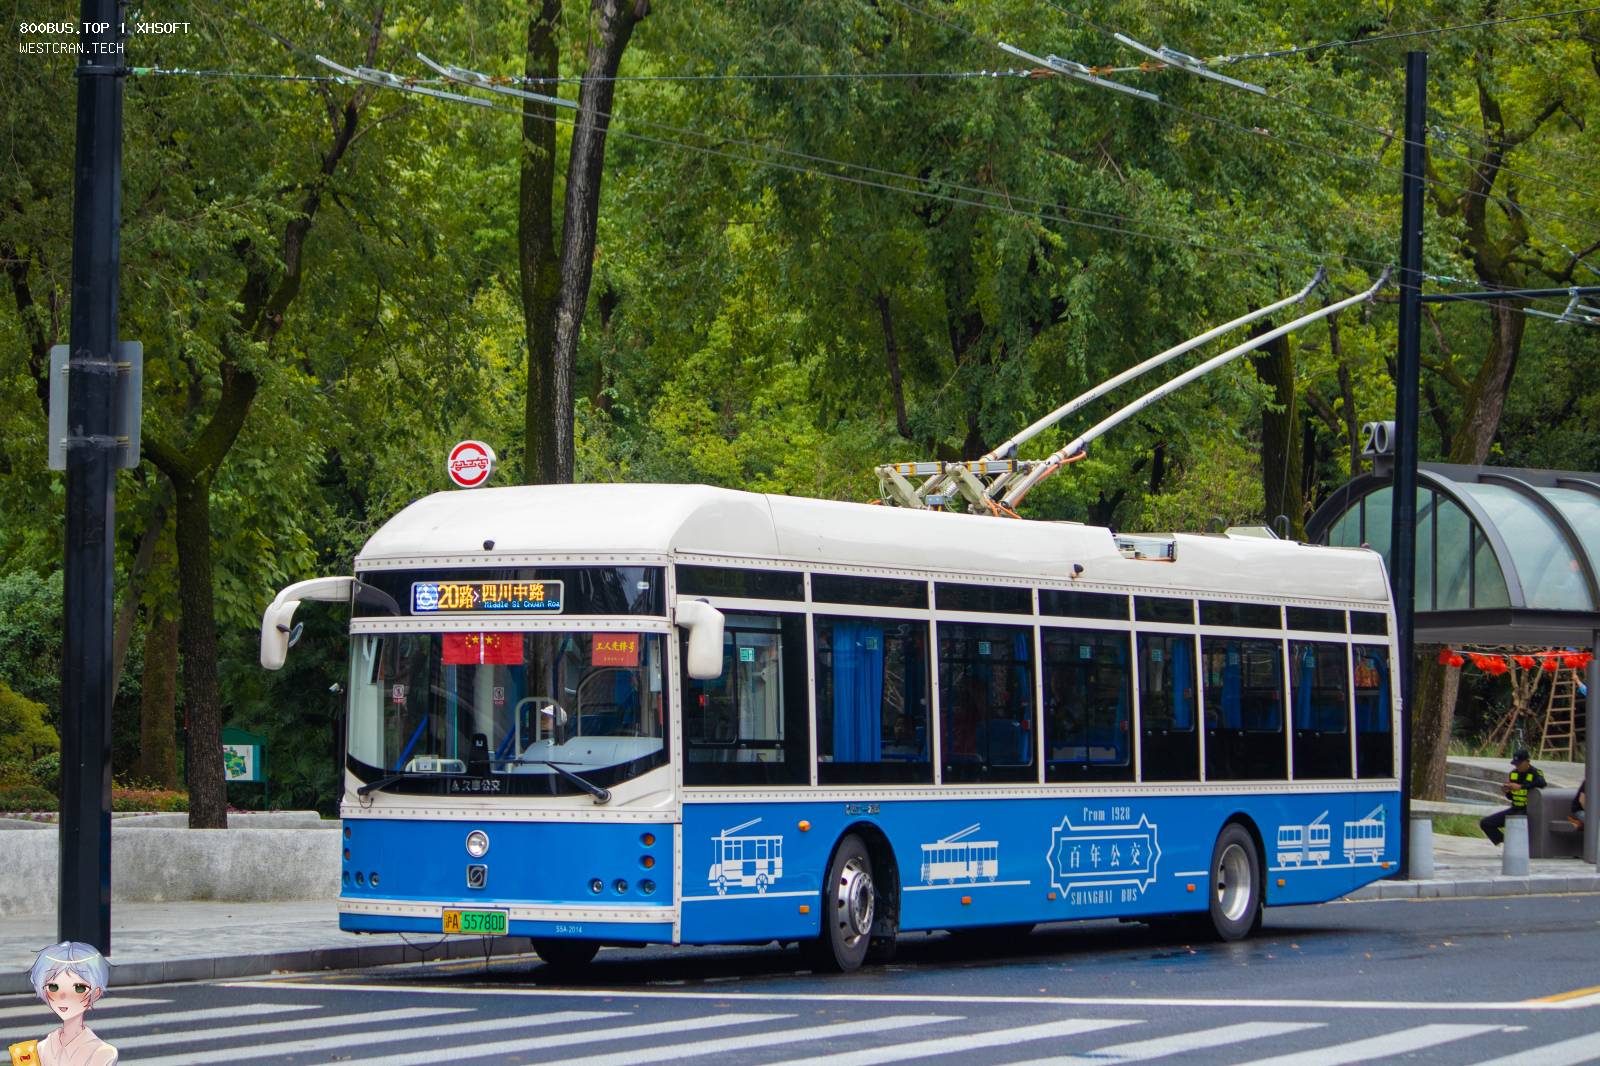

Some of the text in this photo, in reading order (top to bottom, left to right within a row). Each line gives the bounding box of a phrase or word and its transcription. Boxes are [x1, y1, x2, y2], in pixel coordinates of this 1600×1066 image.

[1362, 421, 1389, 454] 20
[438, 583, 545, 609] 20路 四川中路
[1083, 806, 1131, 822] From 1928
[1070, 842, 1141, 868] 百年公交
[1071, 888, 1137, 905] SHANGHAI BUS
